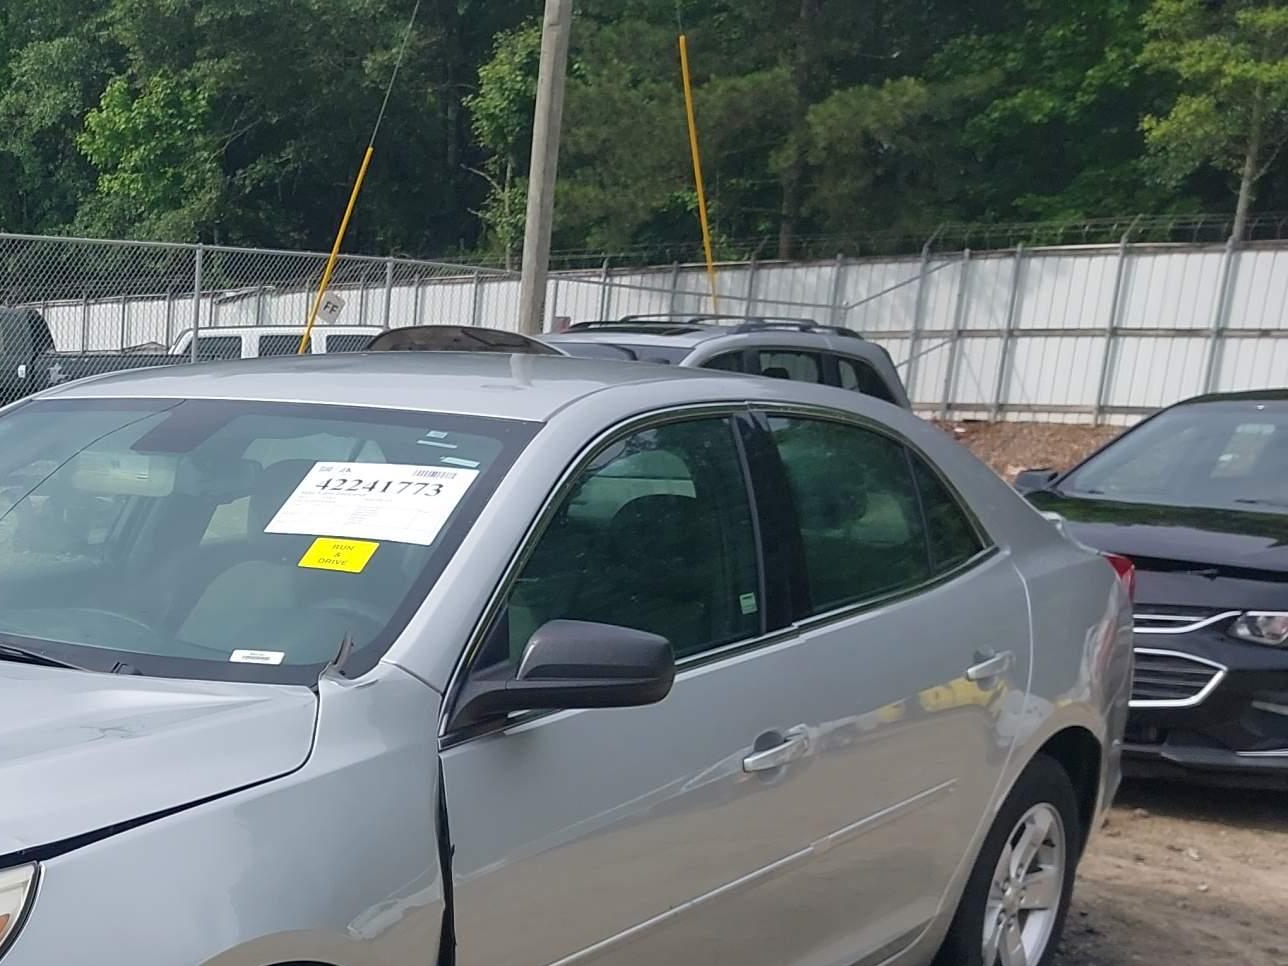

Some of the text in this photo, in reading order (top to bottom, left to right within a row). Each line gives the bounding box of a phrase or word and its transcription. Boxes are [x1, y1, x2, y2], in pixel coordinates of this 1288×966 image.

[323, 300, 339, 315] FF
[315, 478, 444, 497] 42241773
[317, 557, 349, 566] DRIVE
